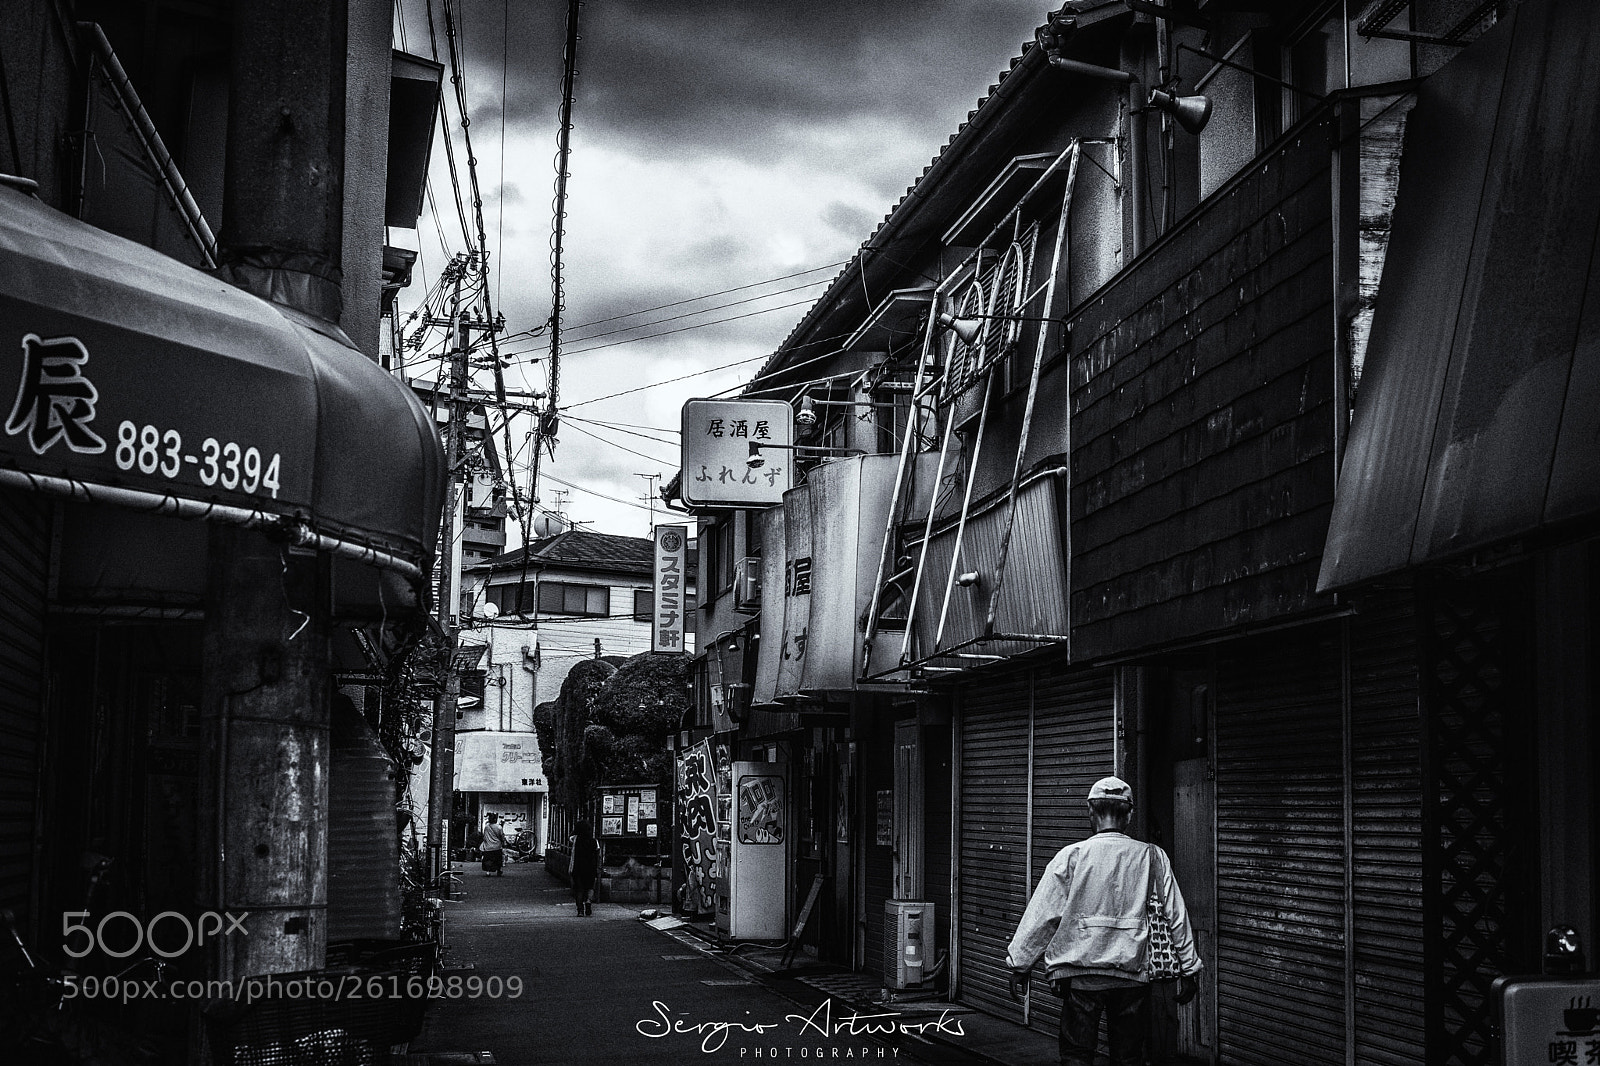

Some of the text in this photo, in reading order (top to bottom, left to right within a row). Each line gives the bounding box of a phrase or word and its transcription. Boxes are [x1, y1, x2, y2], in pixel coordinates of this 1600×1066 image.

[5, 333, 107, 455] 辰
[707, 419, 772, 439] 居酒屋
[115, 420, 280, 499] 883-3394
[695, 465, 782, 487] ふれんず
[658, 556, 680, 647] スタミナ軒
